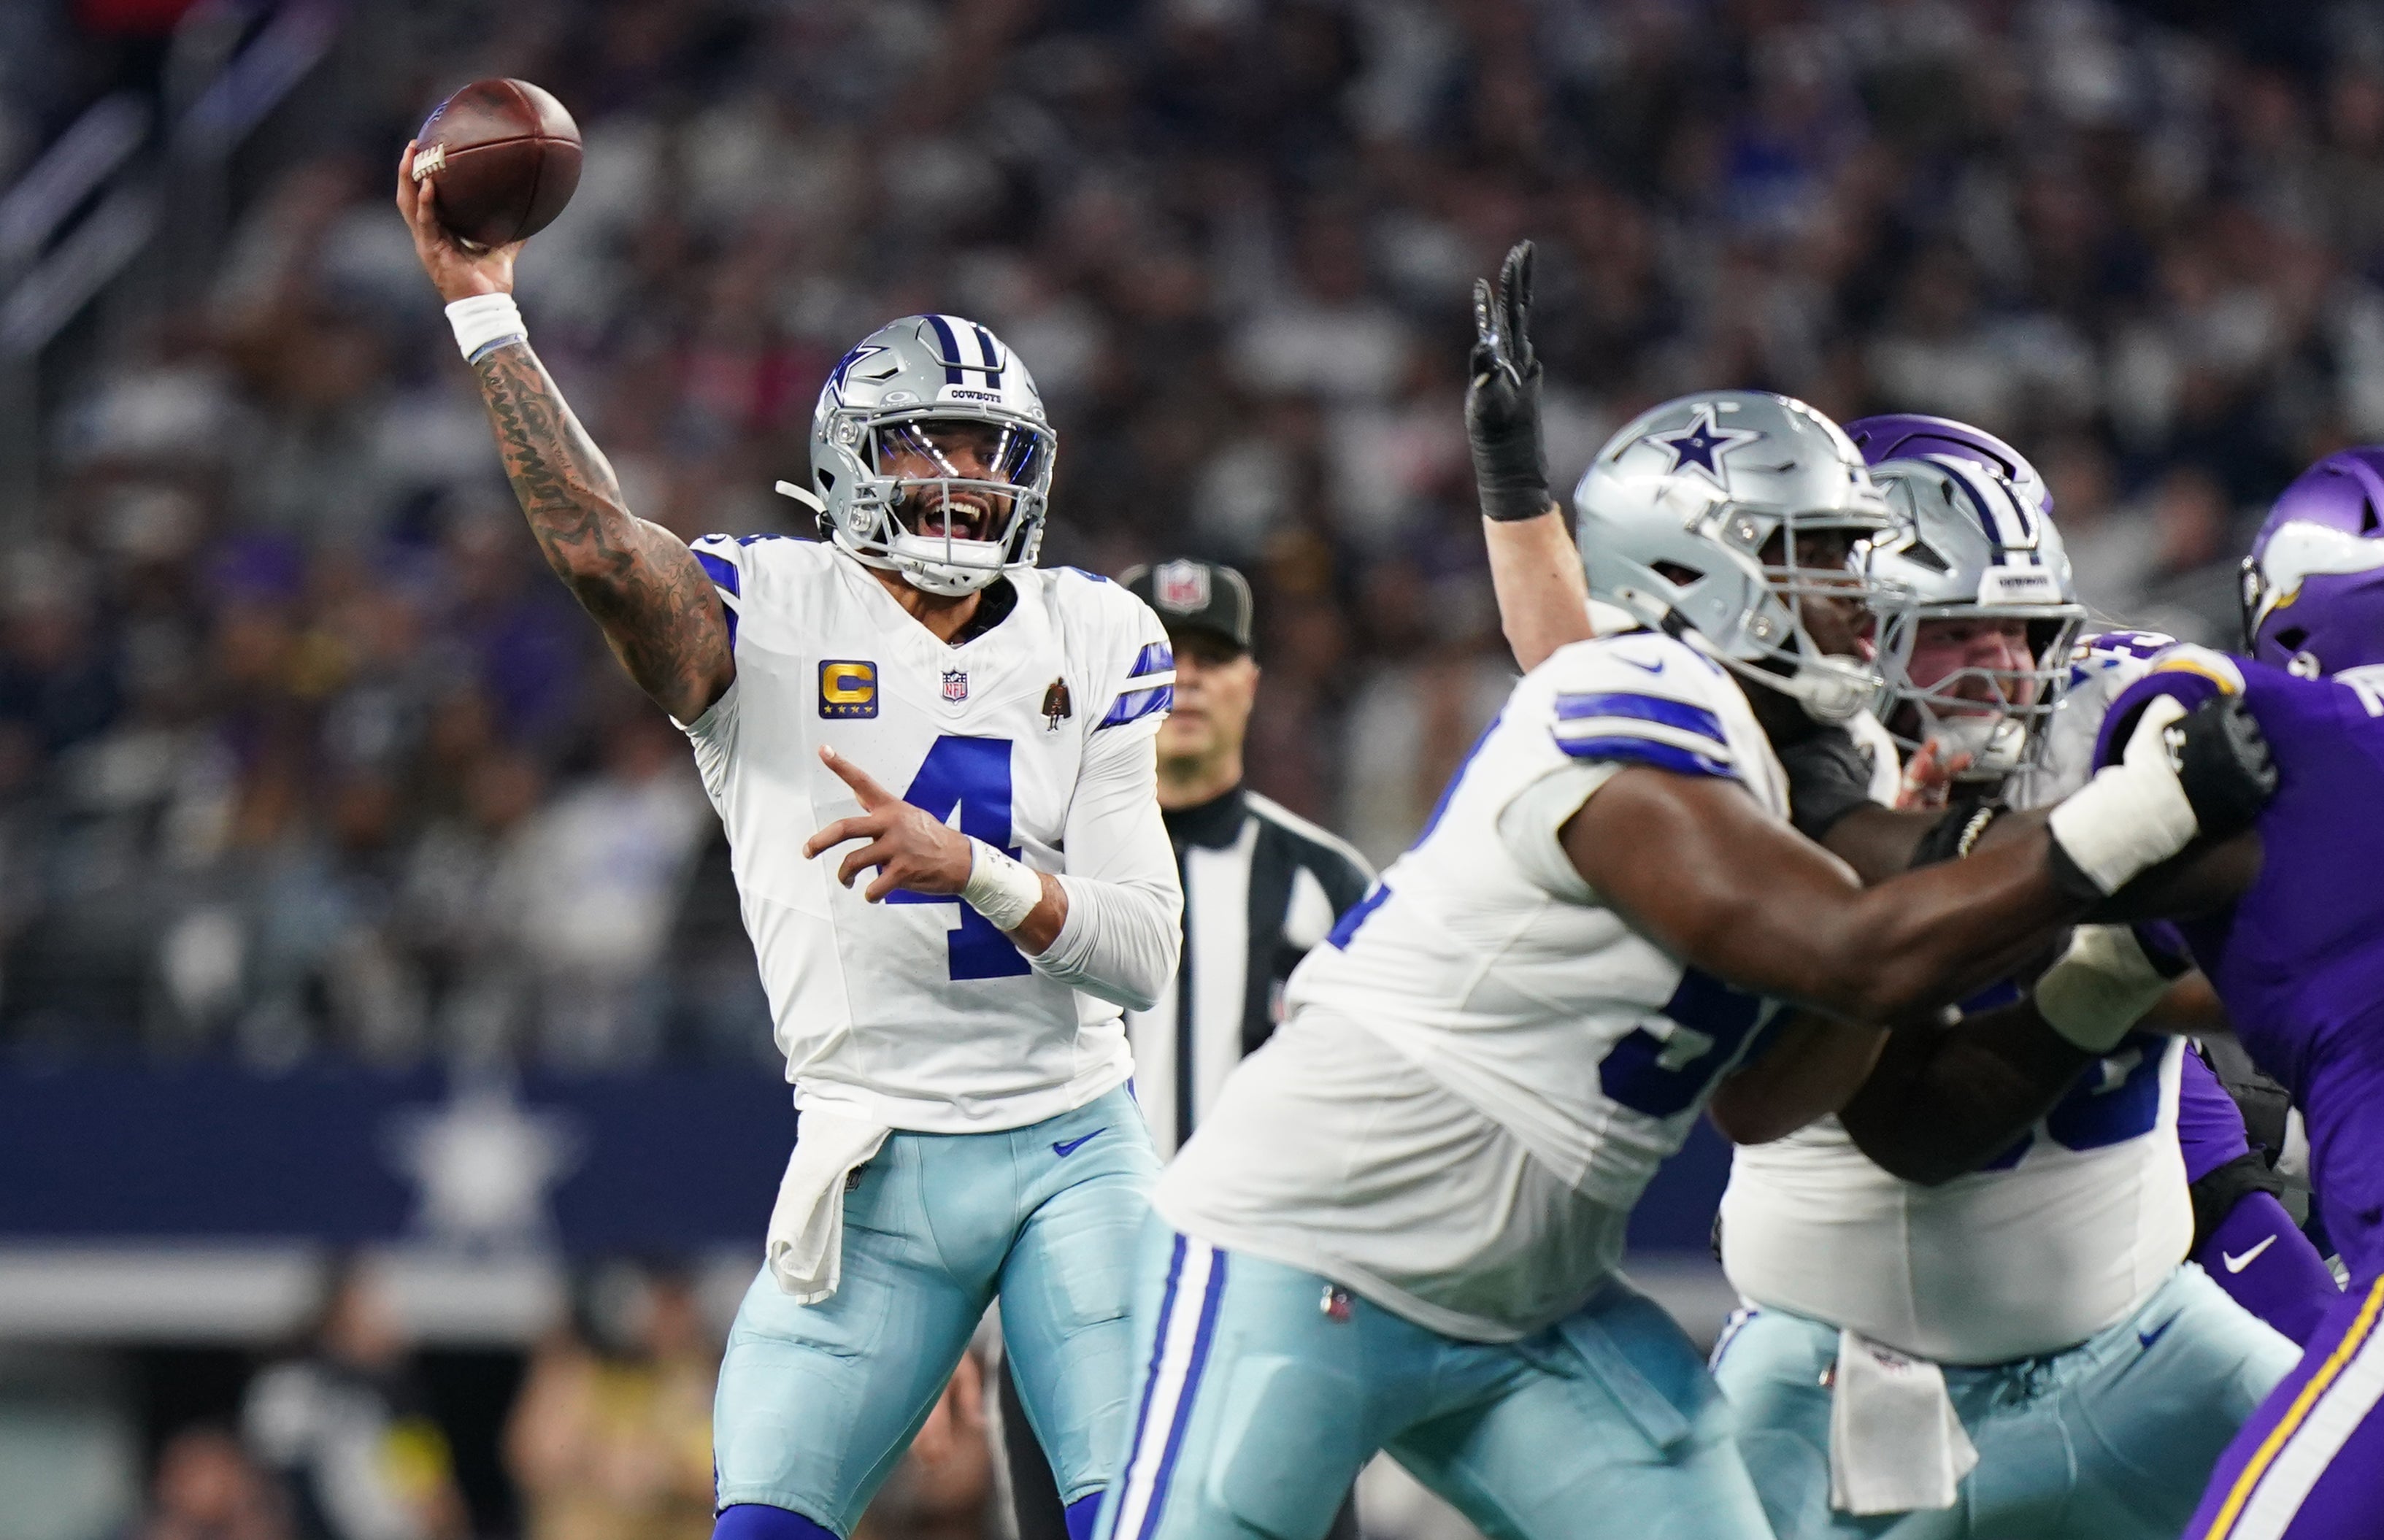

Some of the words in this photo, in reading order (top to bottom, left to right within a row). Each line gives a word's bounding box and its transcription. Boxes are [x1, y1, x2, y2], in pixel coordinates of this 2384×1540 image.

[951, 390, 1001, 403] COWBOYS
[823, 663, 874, 704] C
[945, 682, 966, 698] NFL
[876, 735, 1032, 980] 4
